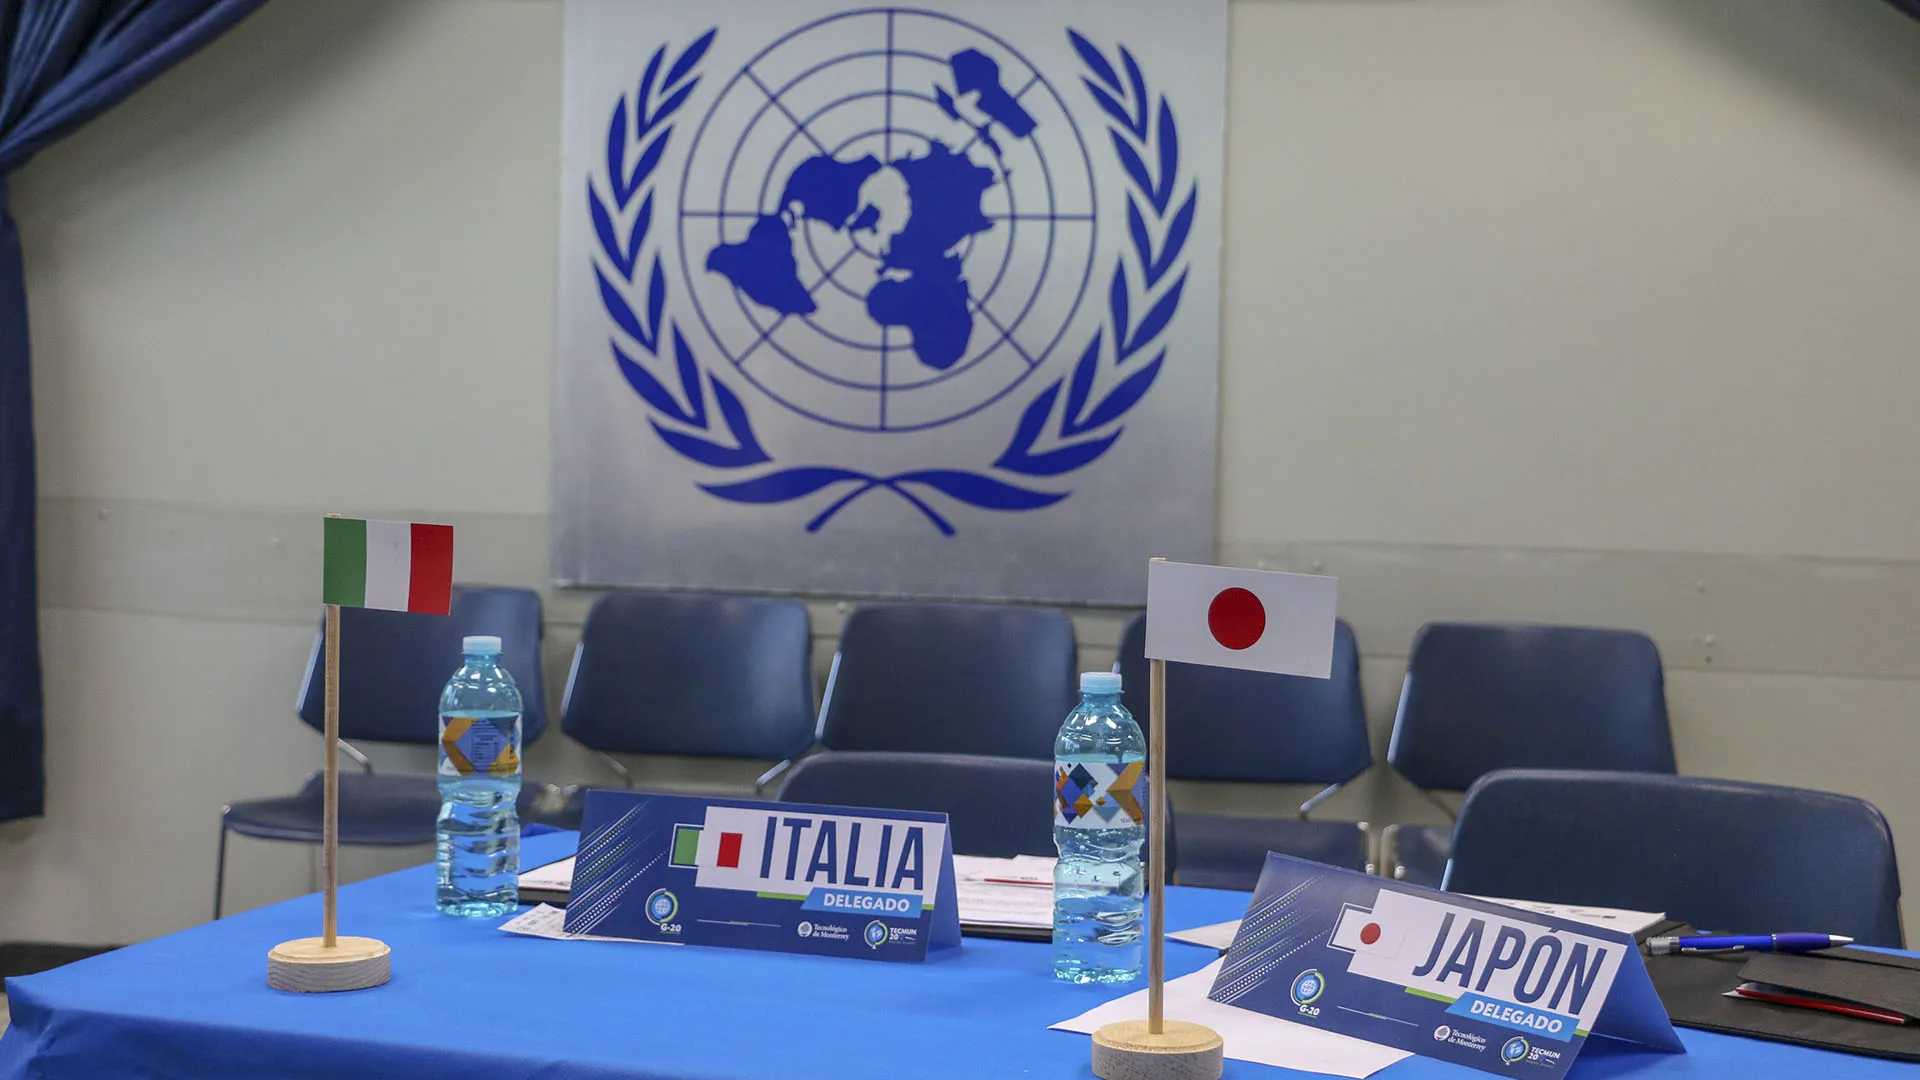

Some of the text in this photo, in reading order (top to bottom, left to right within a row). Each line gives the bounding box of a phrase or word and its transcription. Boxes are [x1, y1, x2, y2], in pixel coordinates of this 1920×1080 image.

[759, 816, 924, 891] ITALIA
[823, 893, 910, 912] DELEGADO
[660, 923, 682, 932] G-20
[814, 923, 848, 934] Tecnológico
[889, 927, 917, 935] TECMUN
[820, 931, 850, 941] Monterrey
[1411, 911, 1608, 1016] JAPÓN
[1299, 1004, 1320, 1016] G-20
[1470, 999, 1563, 1033] DELEGADO
[1452, 1029, 1487, 1043] Tecnológico
[1455, 1039, 1487, 1053] Monterrey
[1530, 1046, 1560, 1059] TECMUN
